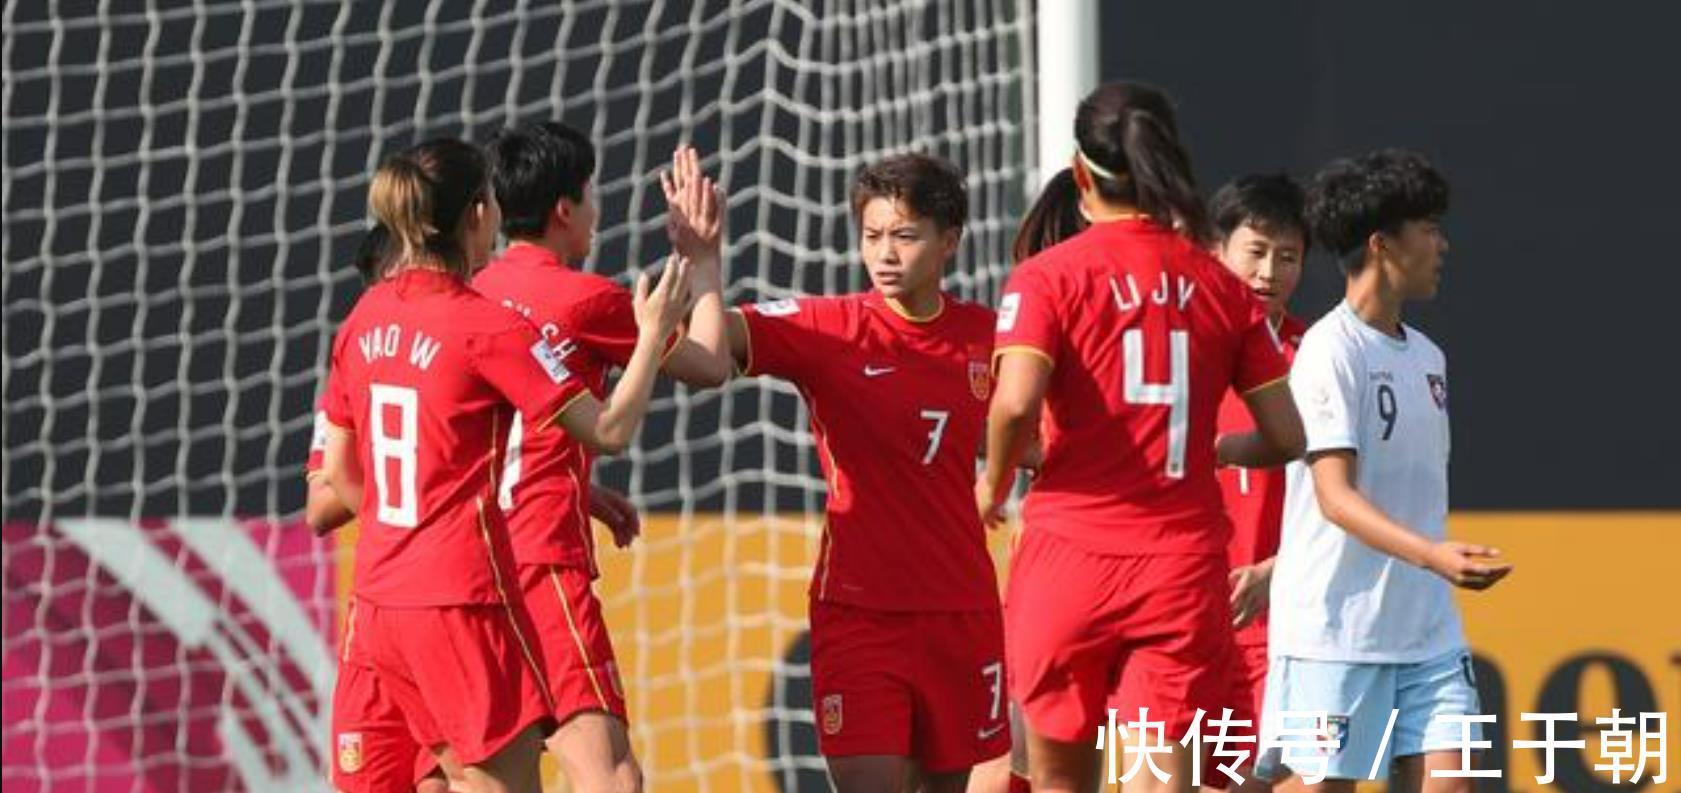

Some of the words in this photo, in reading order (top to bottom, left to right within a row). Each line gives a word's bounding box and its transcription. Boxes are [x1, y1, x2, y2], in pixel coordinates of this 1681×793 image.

[1109, 273, 1142, 312] LI
[1152, 271, 1195, 310] JY
[359, 324, 401, 363] YAO
[409, 330, 441, 370] W
[1123, 328, 1189, 480] 4
[1377, 383, 1397, 441] 9
[370, 383, 418, 529] 8
[920, 409, 949, 465] 7
[982, 661, 1003, 720] 7
